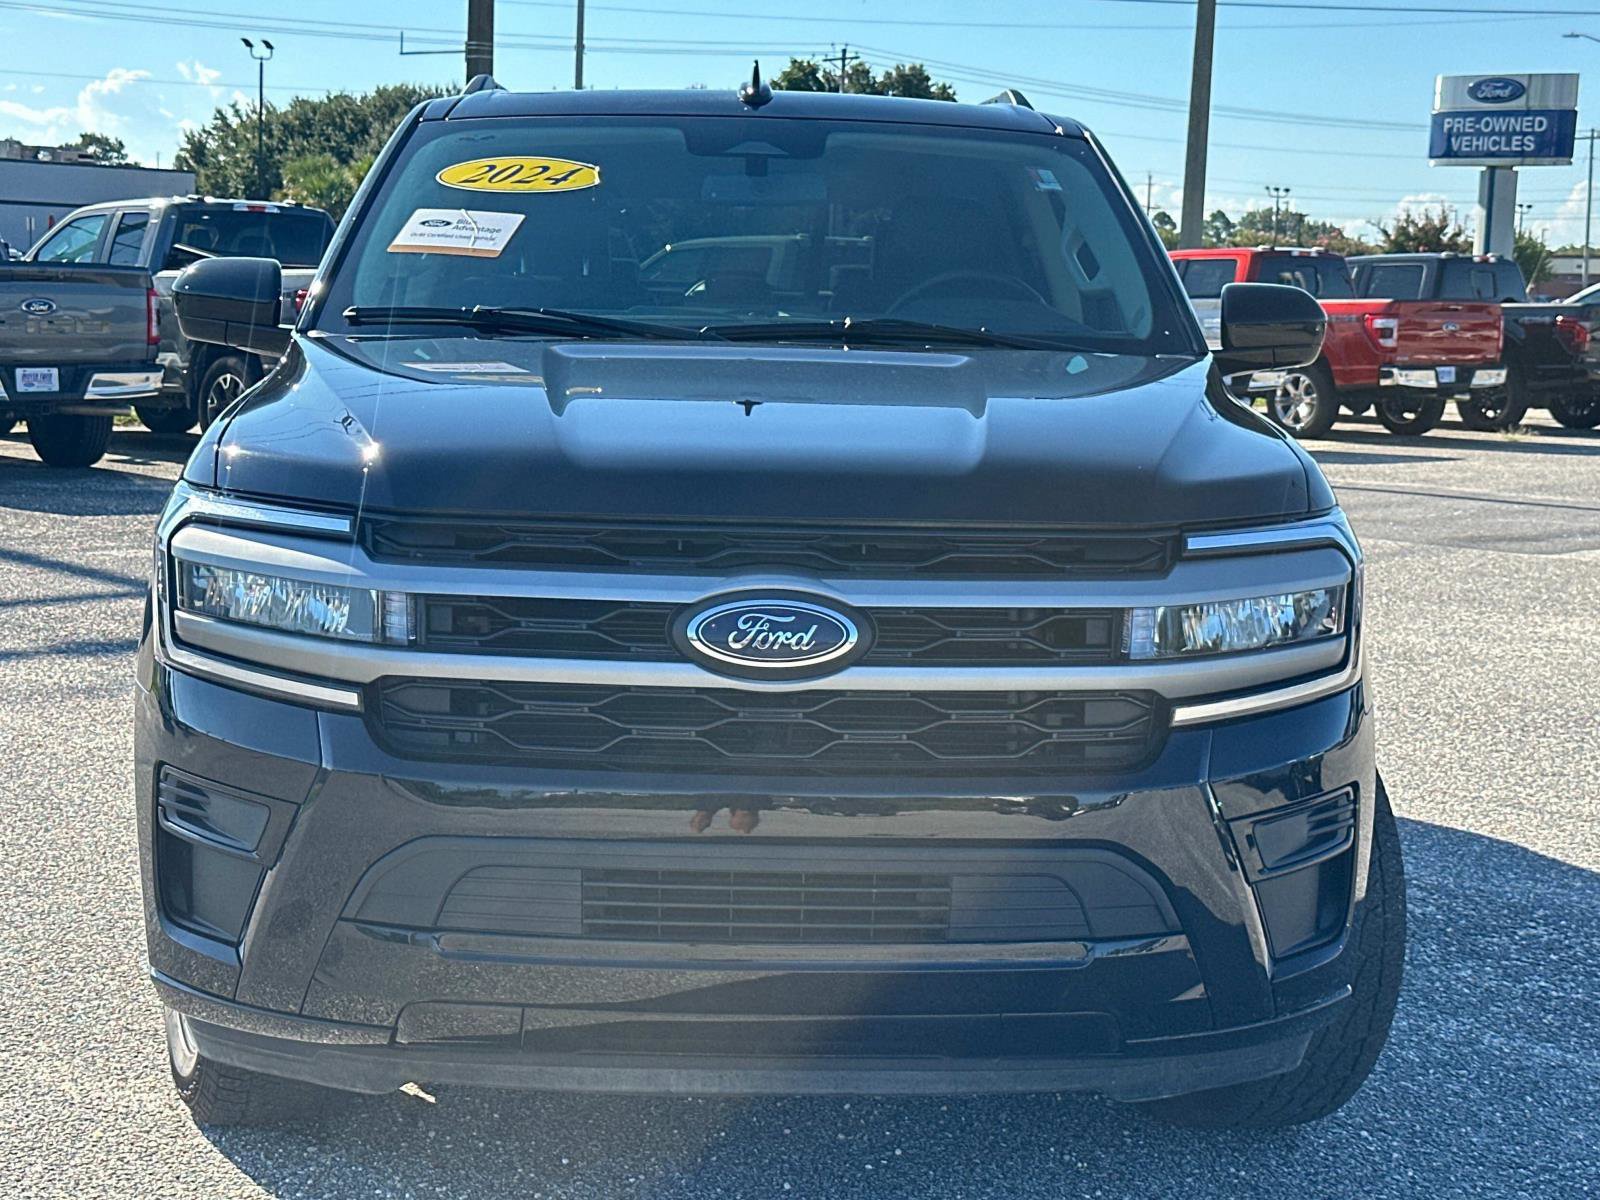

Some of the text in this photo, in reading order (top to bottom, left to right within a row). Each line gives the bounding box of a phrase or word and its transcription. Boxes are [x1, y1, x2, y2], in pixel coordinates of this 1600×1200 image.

[1477, 82, 1513, 99] Ford
[1443, 116, 1548, 133] PRE-OWNED
[1450, 135, 1535, 151] VEHICLES
[456, 164, 583, 186] 2024
[30, 301, 49, 311] Ford
[728, 613, 818, 651] Ford
